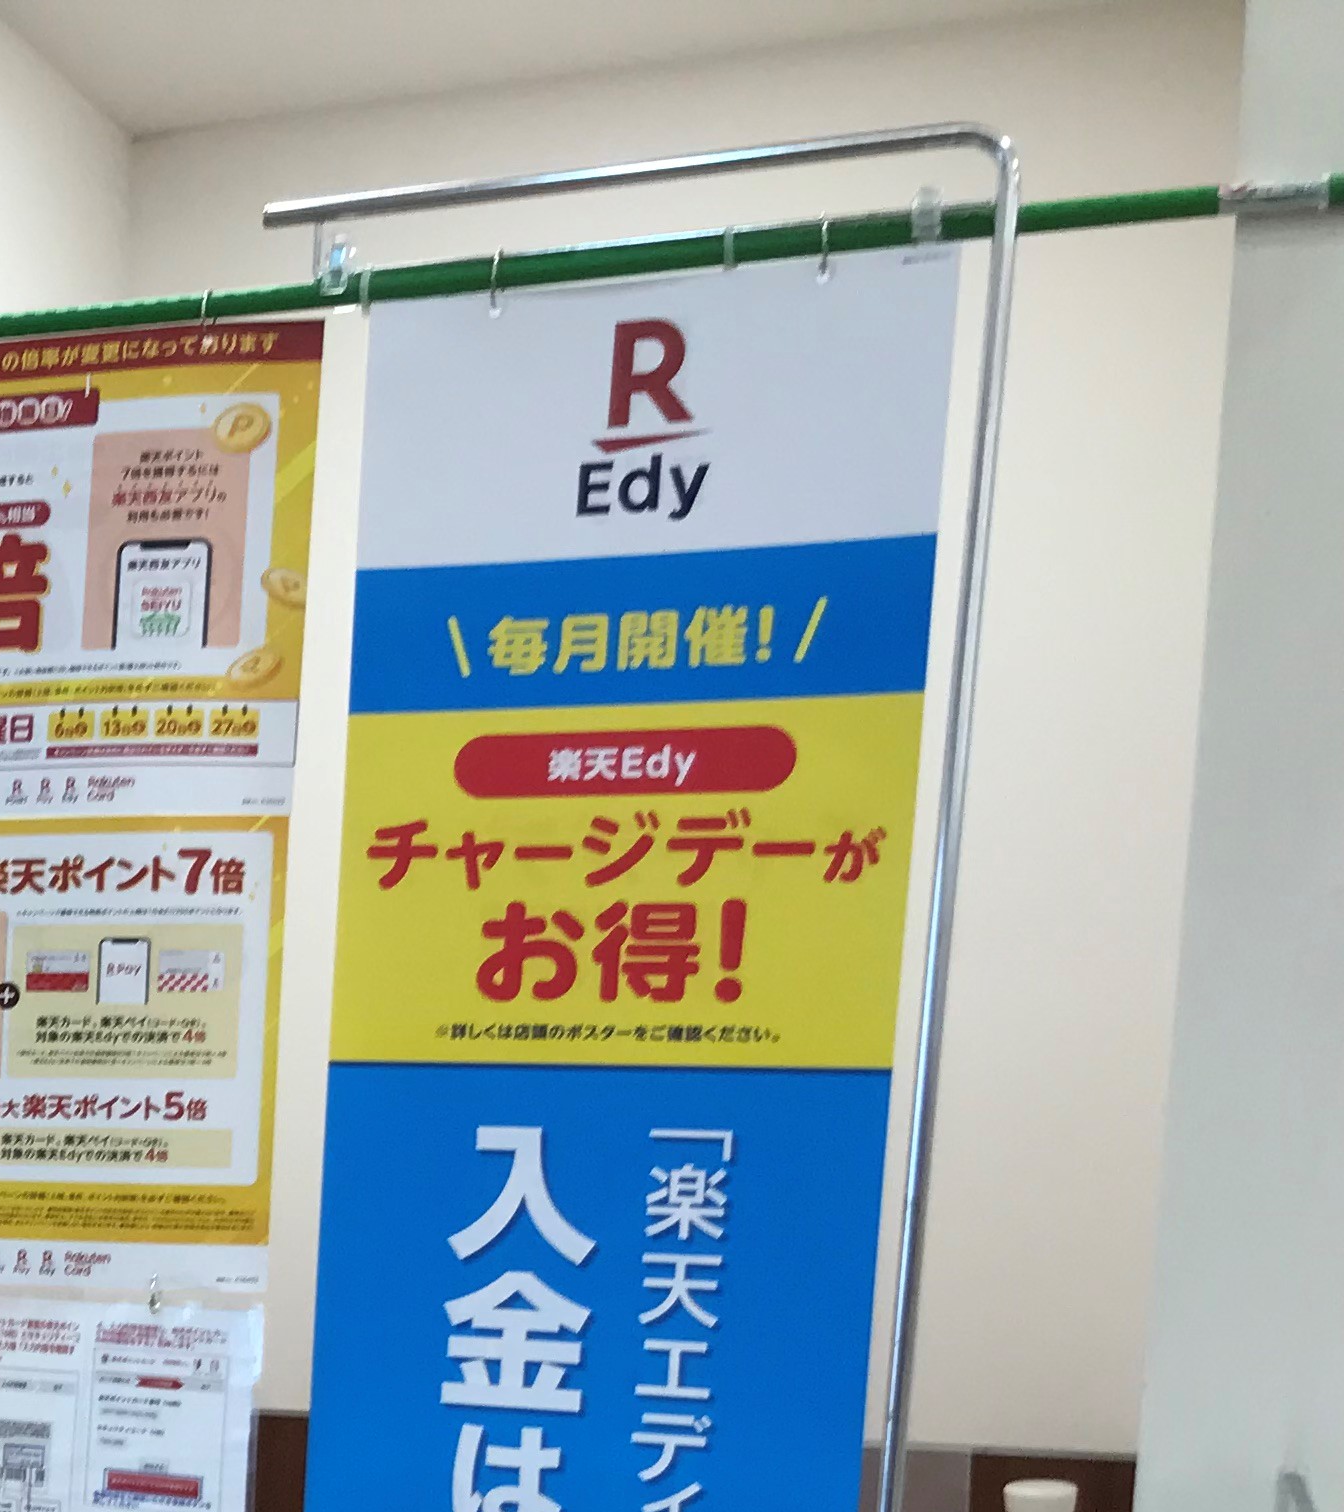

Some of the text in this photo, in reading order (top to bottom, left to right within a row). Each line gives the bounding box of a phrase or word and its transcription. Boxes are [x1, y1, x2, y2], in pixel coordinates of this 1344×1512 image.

[607, 318, 694, 430] R
[576, 453, 710, 520] Edy
[547, 745, 697, 786] 楽天Edy
[367, 808, 887, 890] チャージデーが
[475, 899, 748, 1002] お得!
